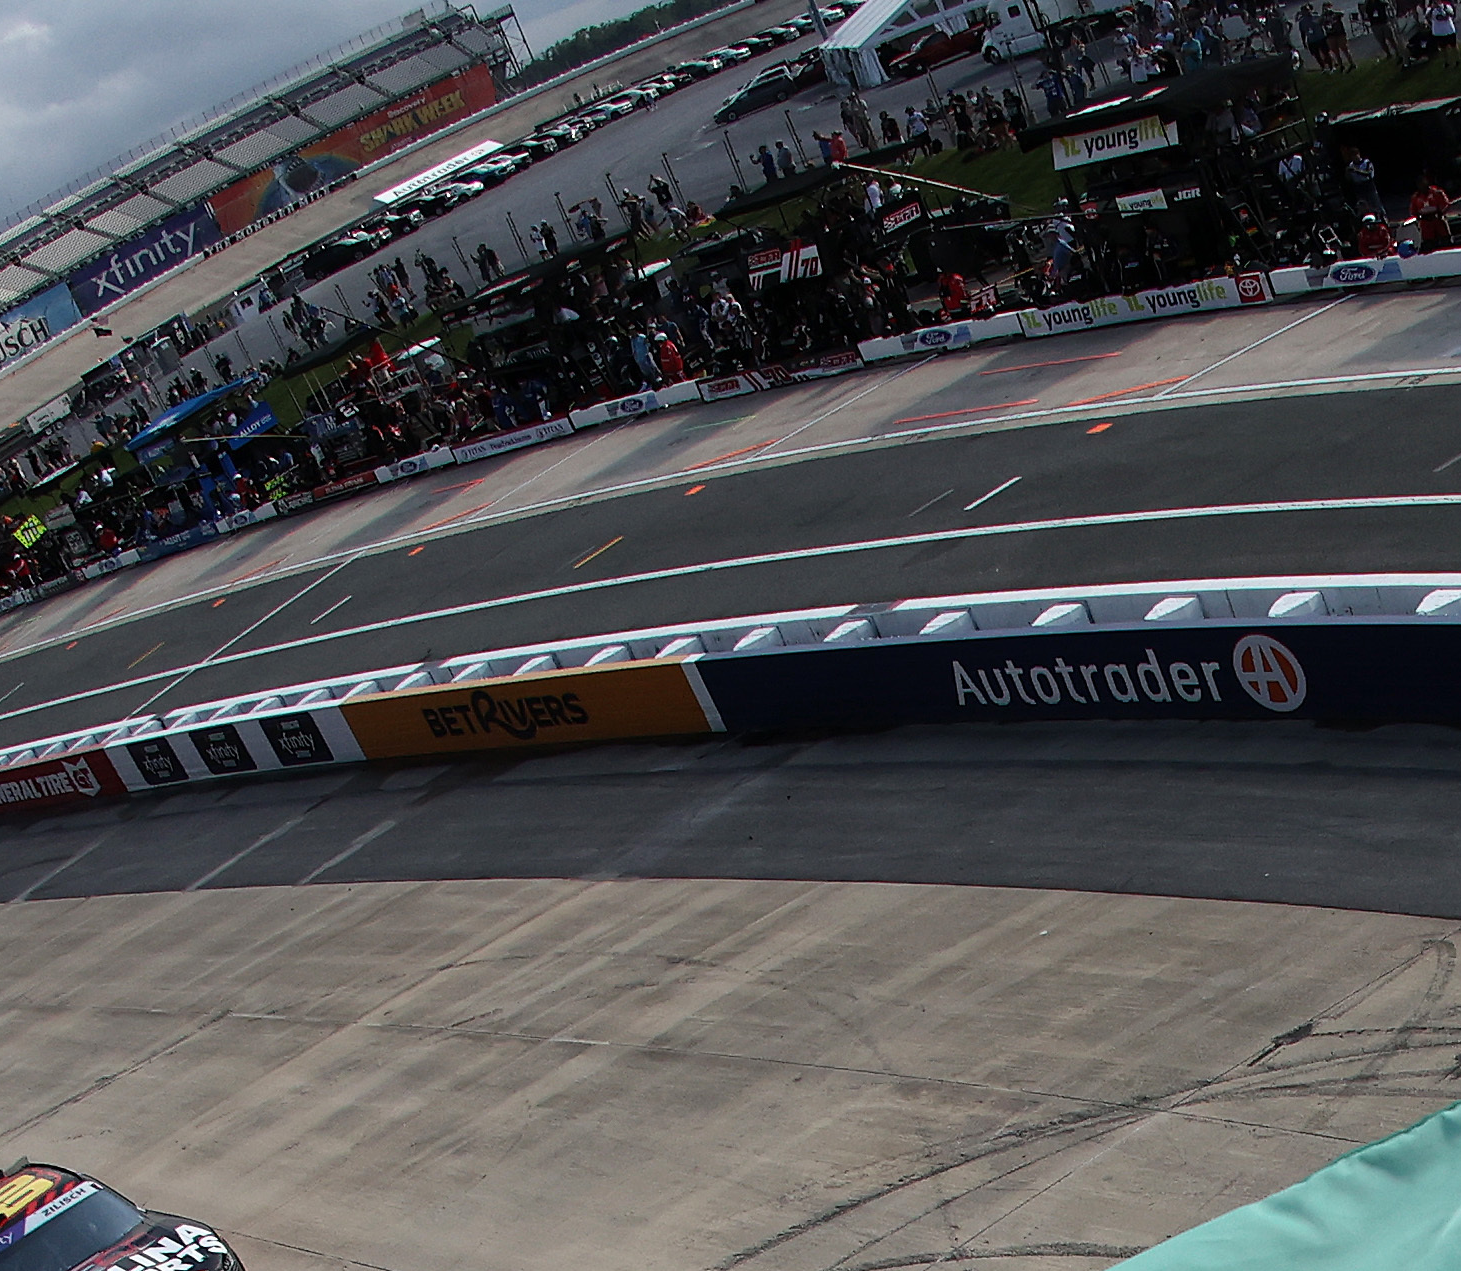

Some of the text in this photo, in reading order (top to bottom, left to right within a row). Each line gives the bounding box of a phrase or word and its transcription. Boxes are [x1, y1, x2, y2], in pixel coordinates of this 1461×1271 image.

[393, 154, 470, 198] Autotrader
[1174, 189, 1201, 203] JGR
[91, 222, 200, 299] xfinity
[1042, 300, 1119, 330] younglife
[1145, 283, 1228, 319] younglife
[952, 648, 1223, 709] Autotrader
[205, 741, 241, 766] xfinity
[278, 731, 316, 756] xfinity
[36, 770, 74, 798] TIRE
[40, 1186, 87, 1218] ZILISCH
